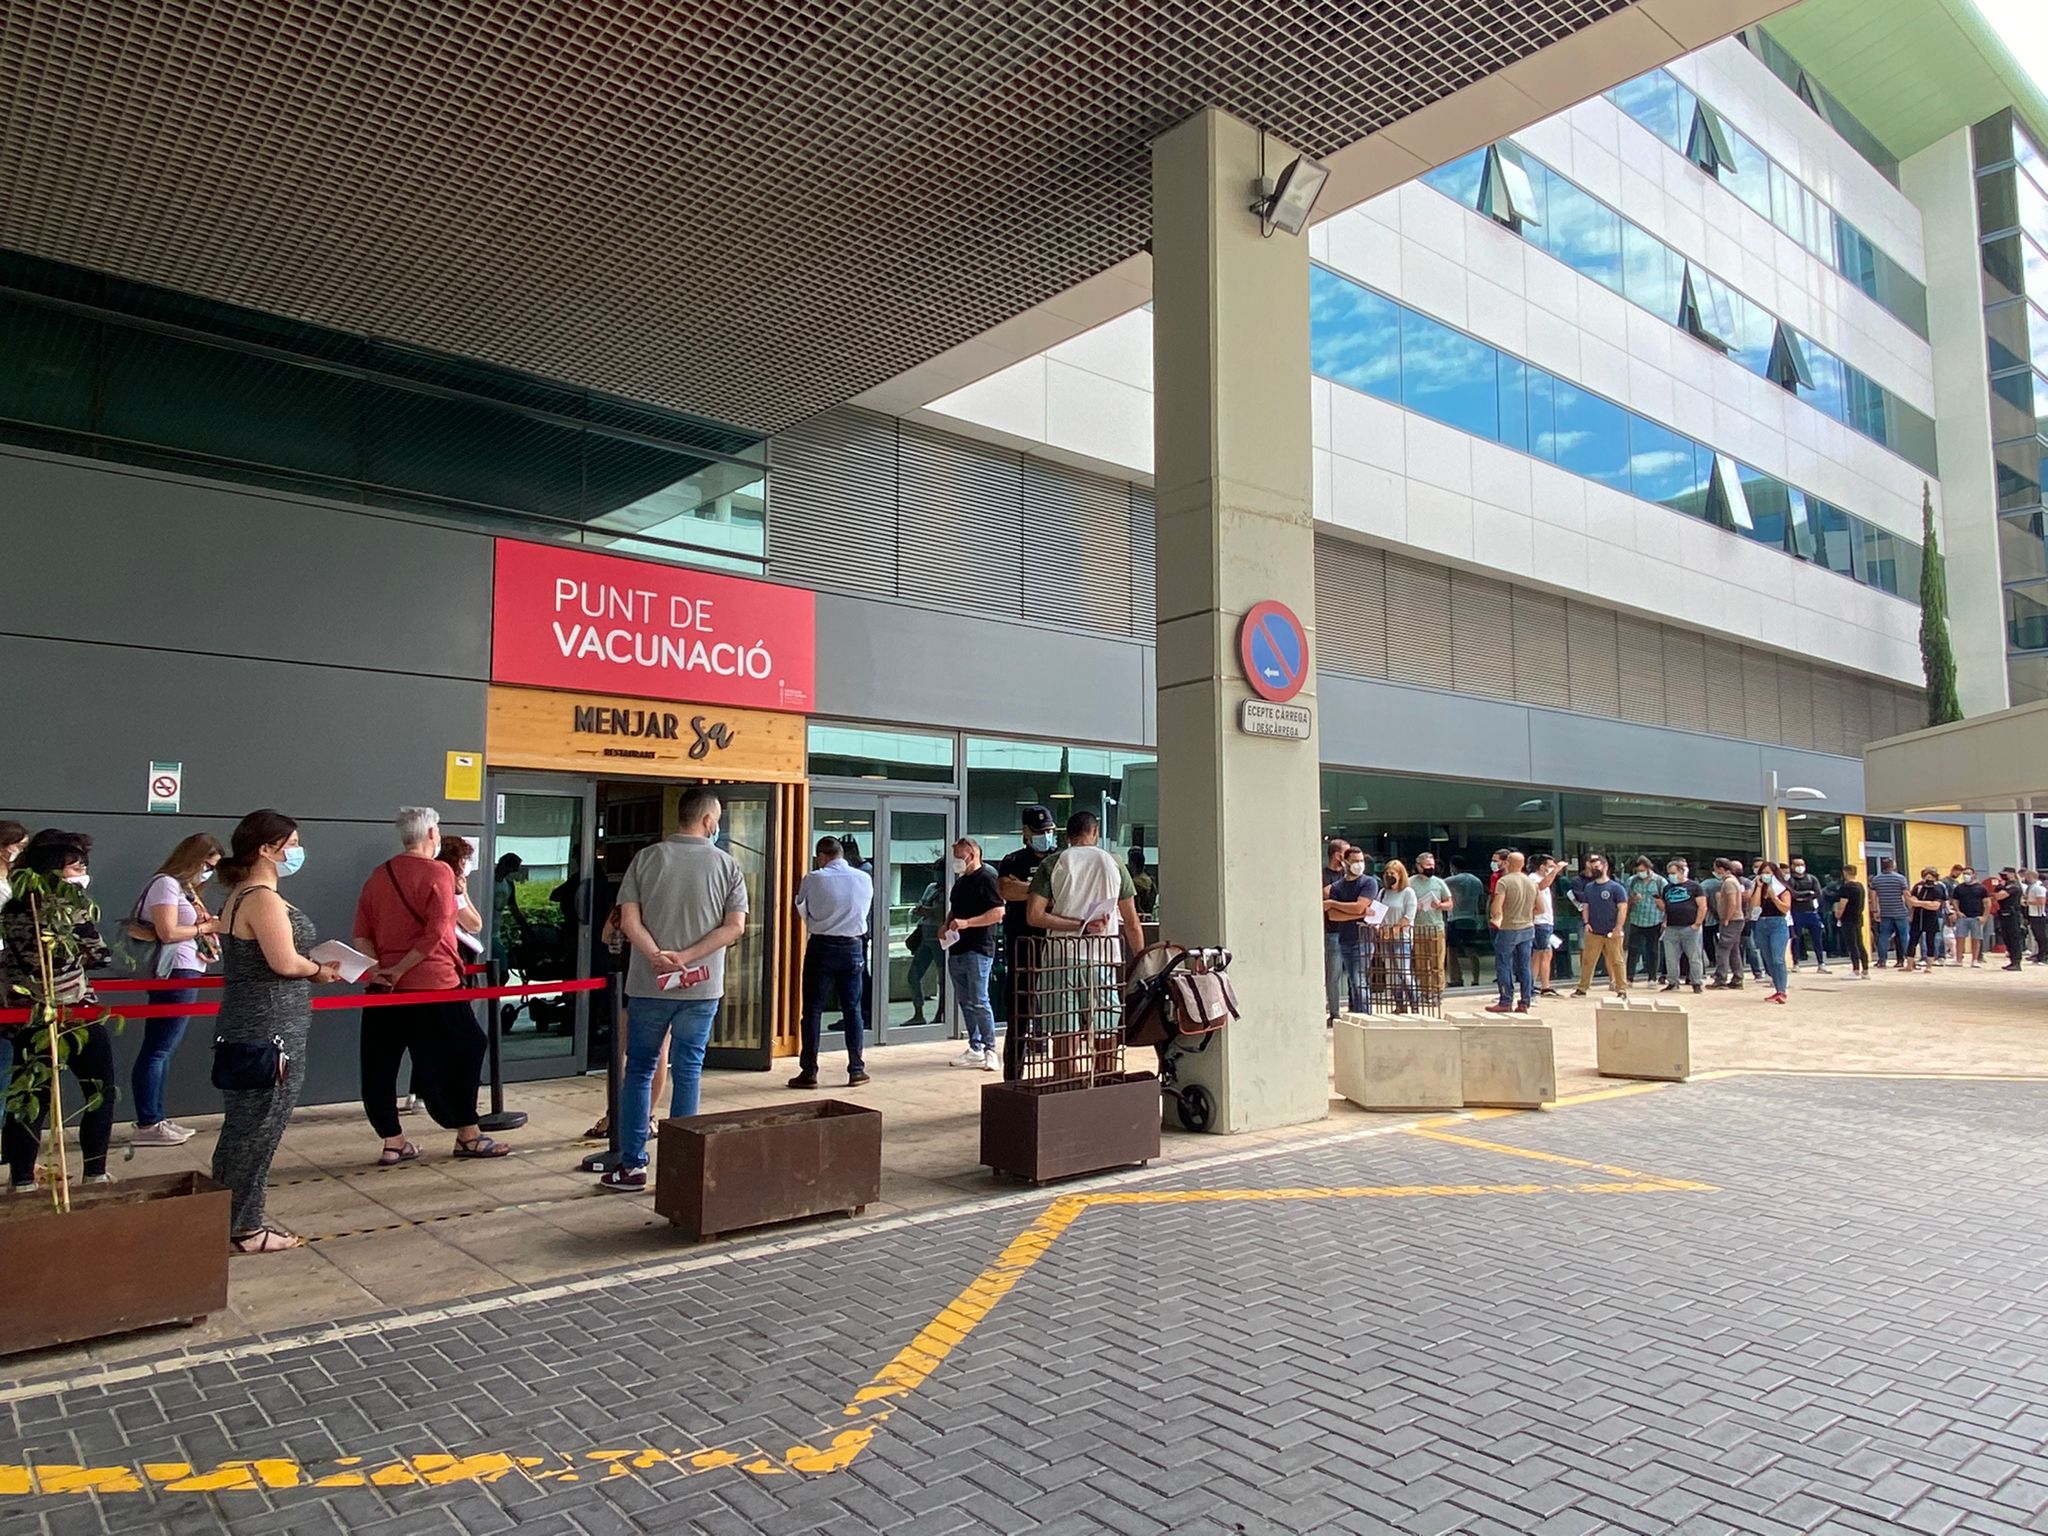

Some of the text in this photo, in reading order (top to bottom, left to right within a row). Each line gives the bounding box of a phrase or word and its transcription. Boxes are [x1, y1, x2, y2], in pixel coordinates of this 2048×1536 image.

[555, 577, 714, 633] PUNT DE
[552, 620, 772, 679] VACUNACIÓ
[574, 705, 679, 740] MENJAR
[1248, 705, 1307, 723] ECEPTE CÀRREGA
[1257, 722, 1298, 736] DESCÀRREGA
